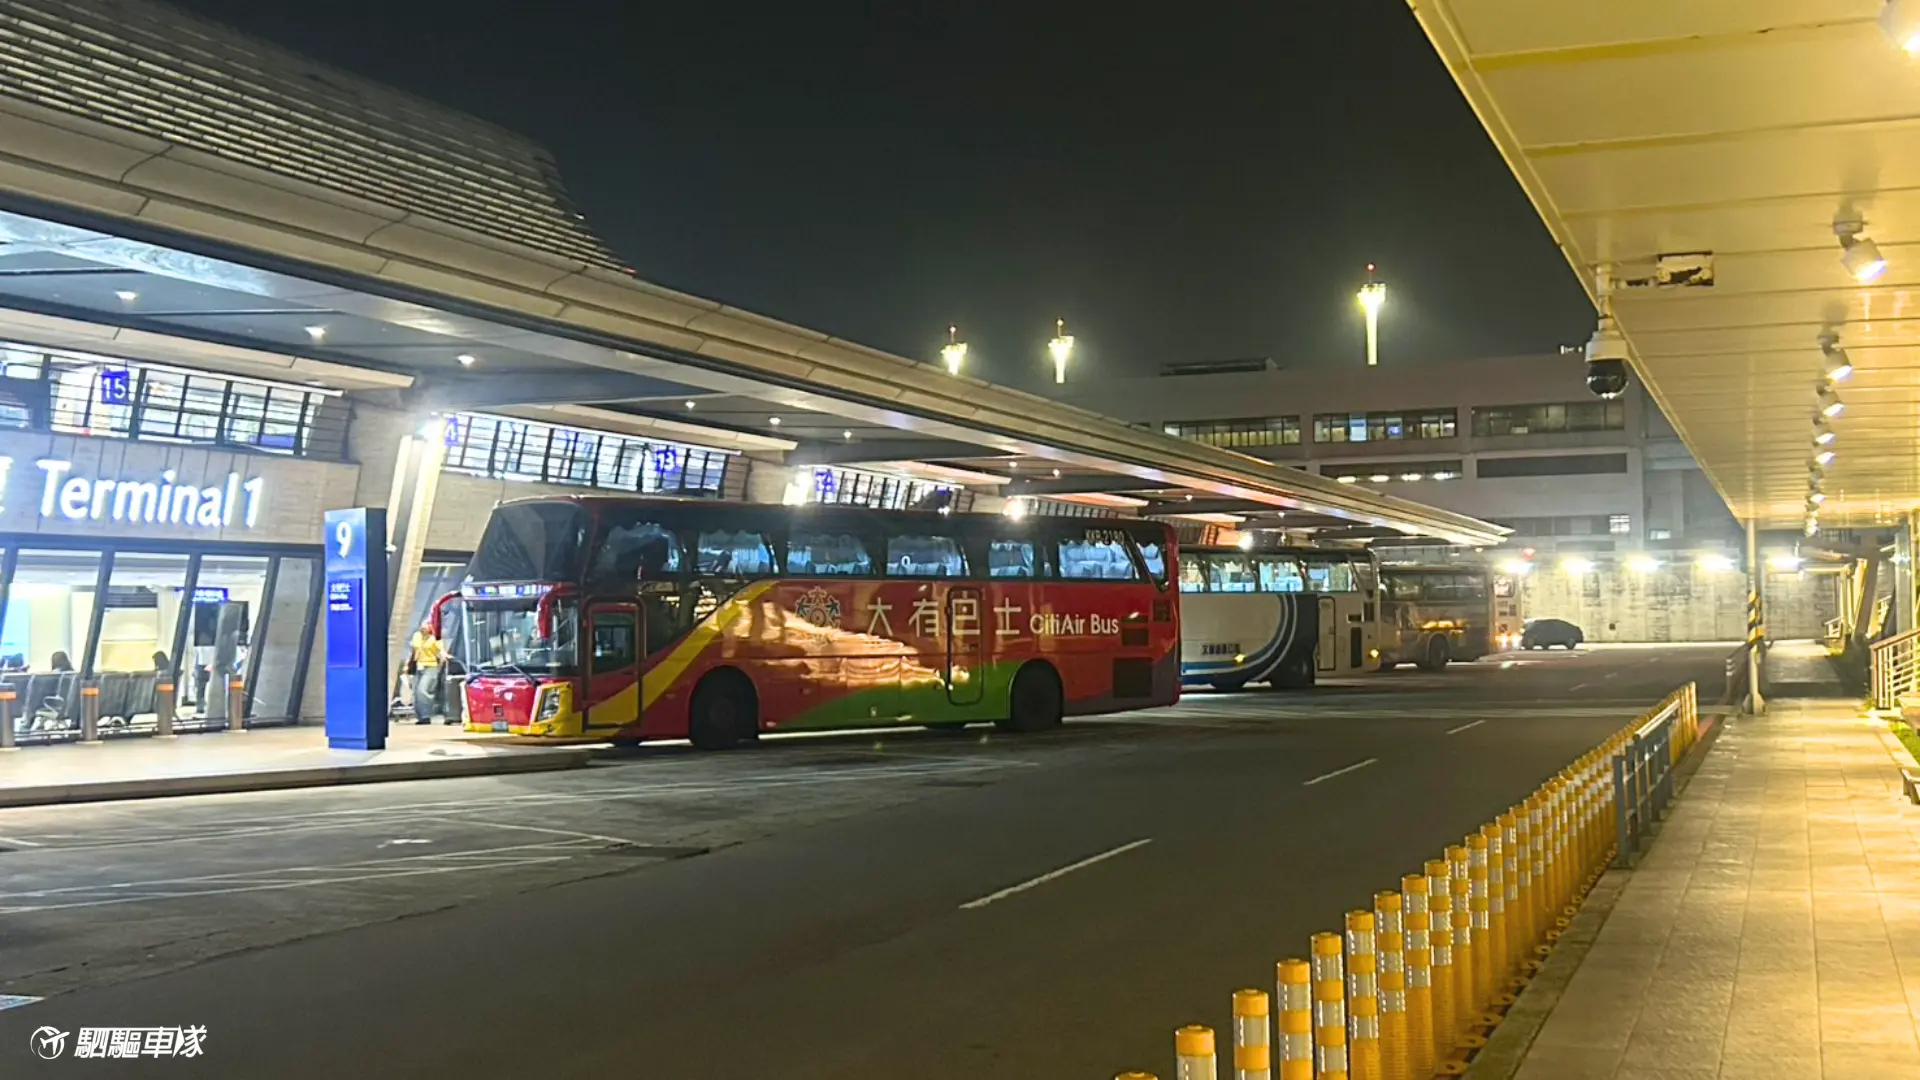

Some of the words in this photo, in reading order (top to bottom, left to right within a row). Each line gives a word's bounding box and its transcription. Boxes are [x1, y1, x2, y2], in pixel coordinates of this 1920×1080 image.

[103, 377, 127, 400] 15
[657, 451, 676, 472] 13
[36, 459, 240, 527] Terminal
[243, 476, 264, 528] 1
[335, 521, 352, 558] 9
[867, 597, 1022, 637] 大有巴士
[1029, 613, 1085, 635] CitiAir
[1090, 615, 1120, 635] Bus
